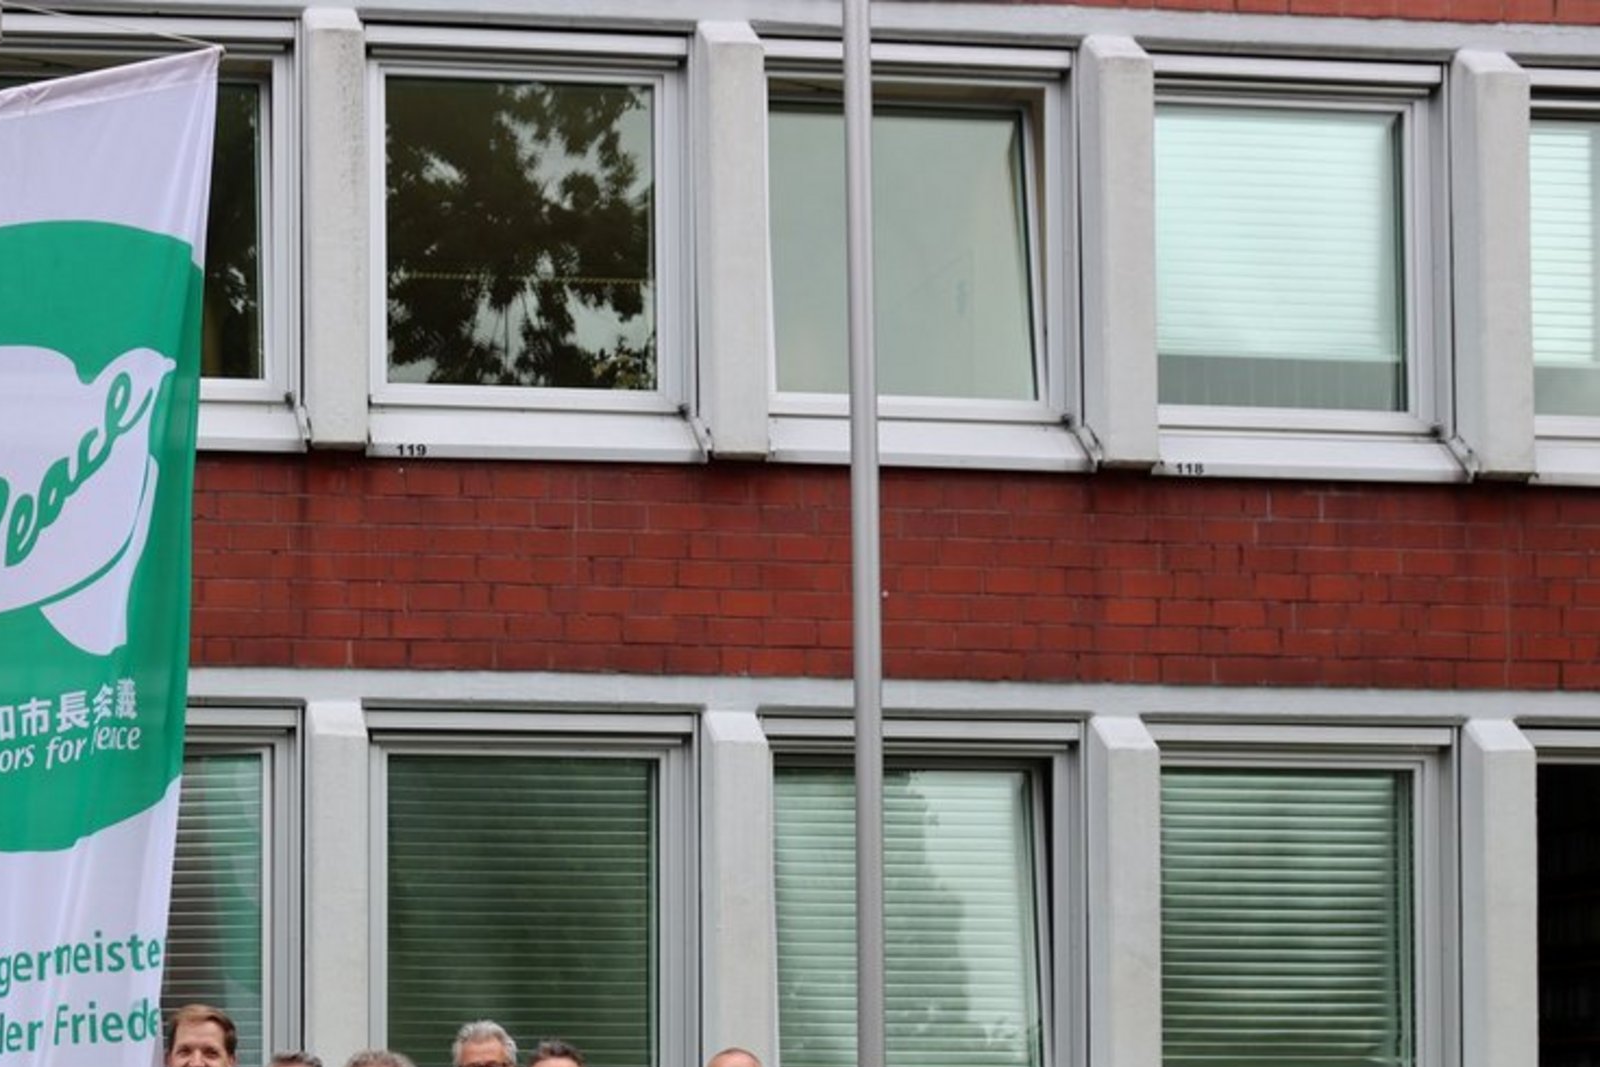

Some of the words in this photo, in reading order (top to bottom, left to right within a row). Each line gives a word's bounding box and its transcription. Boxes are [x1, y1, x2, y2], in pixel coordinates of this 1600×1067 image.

[395, 443, 428, 456] 119
[45, 736, 88, 770] for
[90, 726, 141, 755] ece
